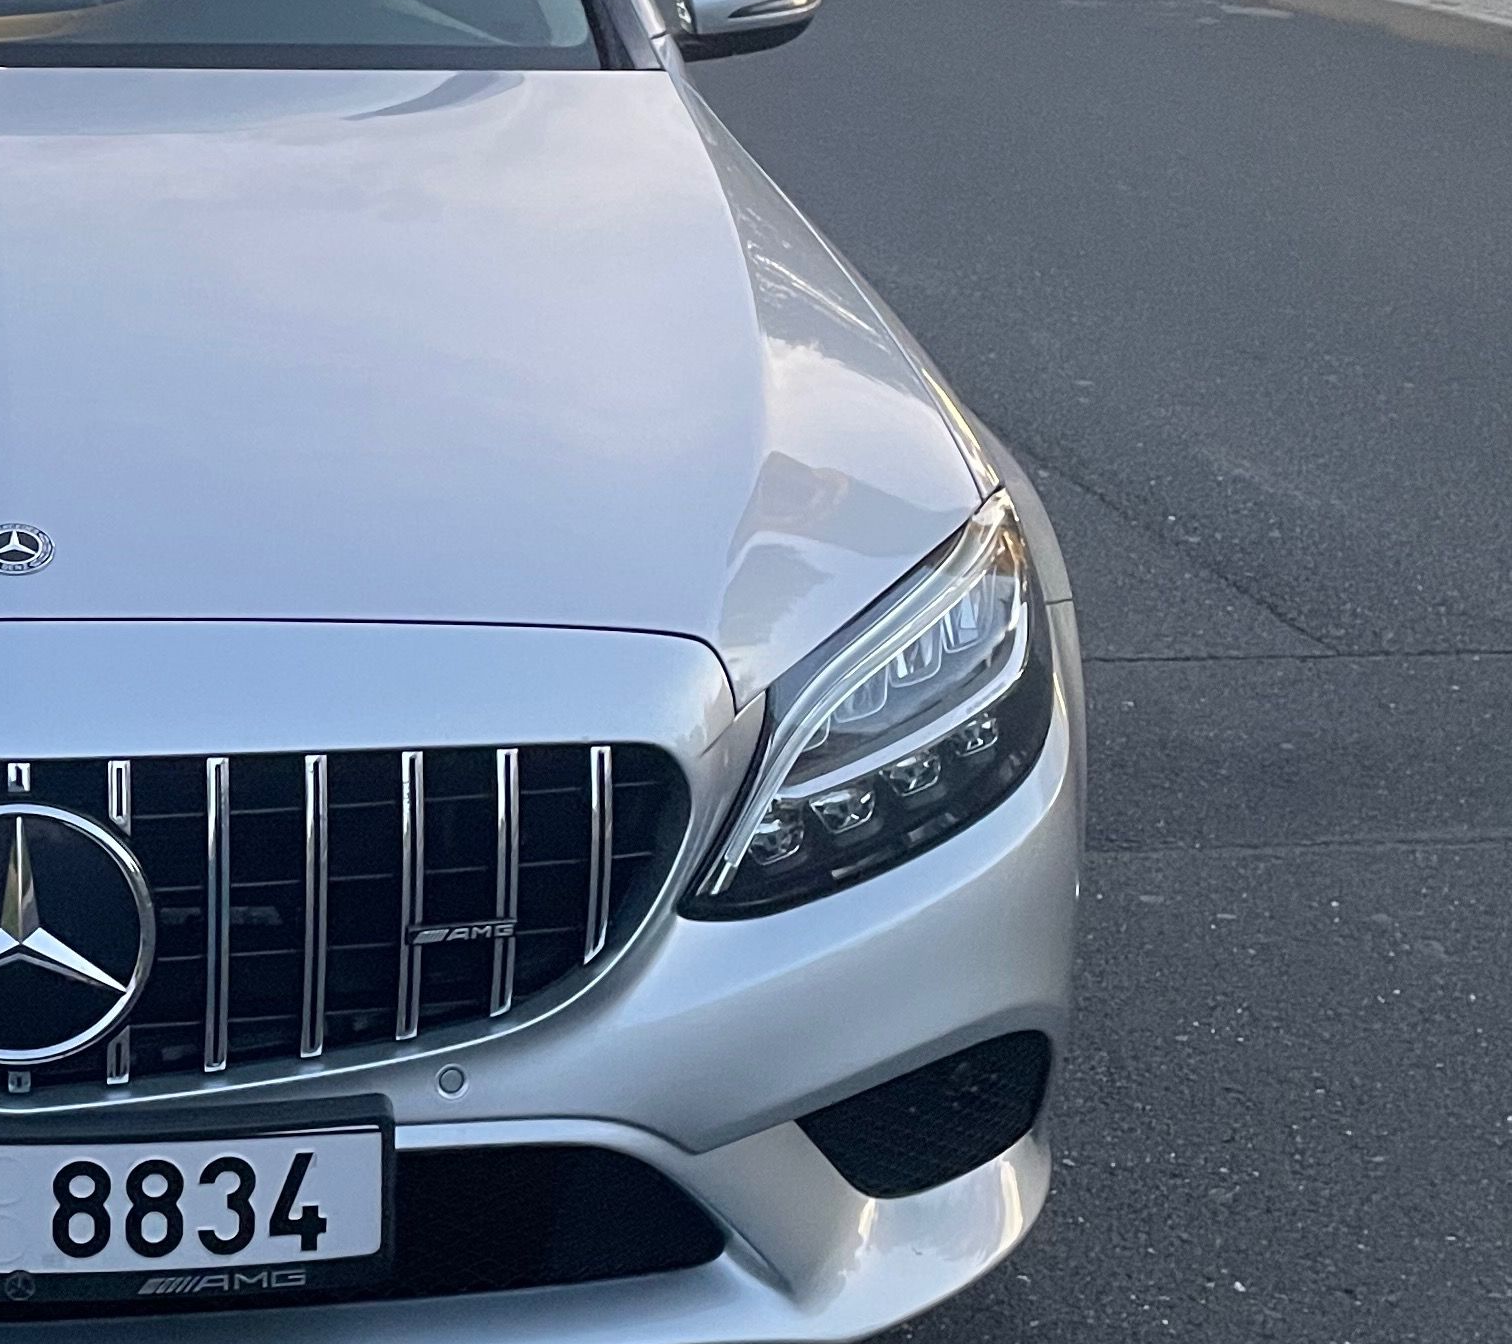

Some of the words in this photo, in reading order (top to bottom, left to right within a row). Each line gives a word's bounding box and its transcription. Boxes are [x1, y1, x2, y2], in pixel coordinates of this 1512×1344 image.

[445, 924, 514, 941] AMG
[52, 1152, 327, 1258] 8834
[191, 1269, 306, 1293] AMG
